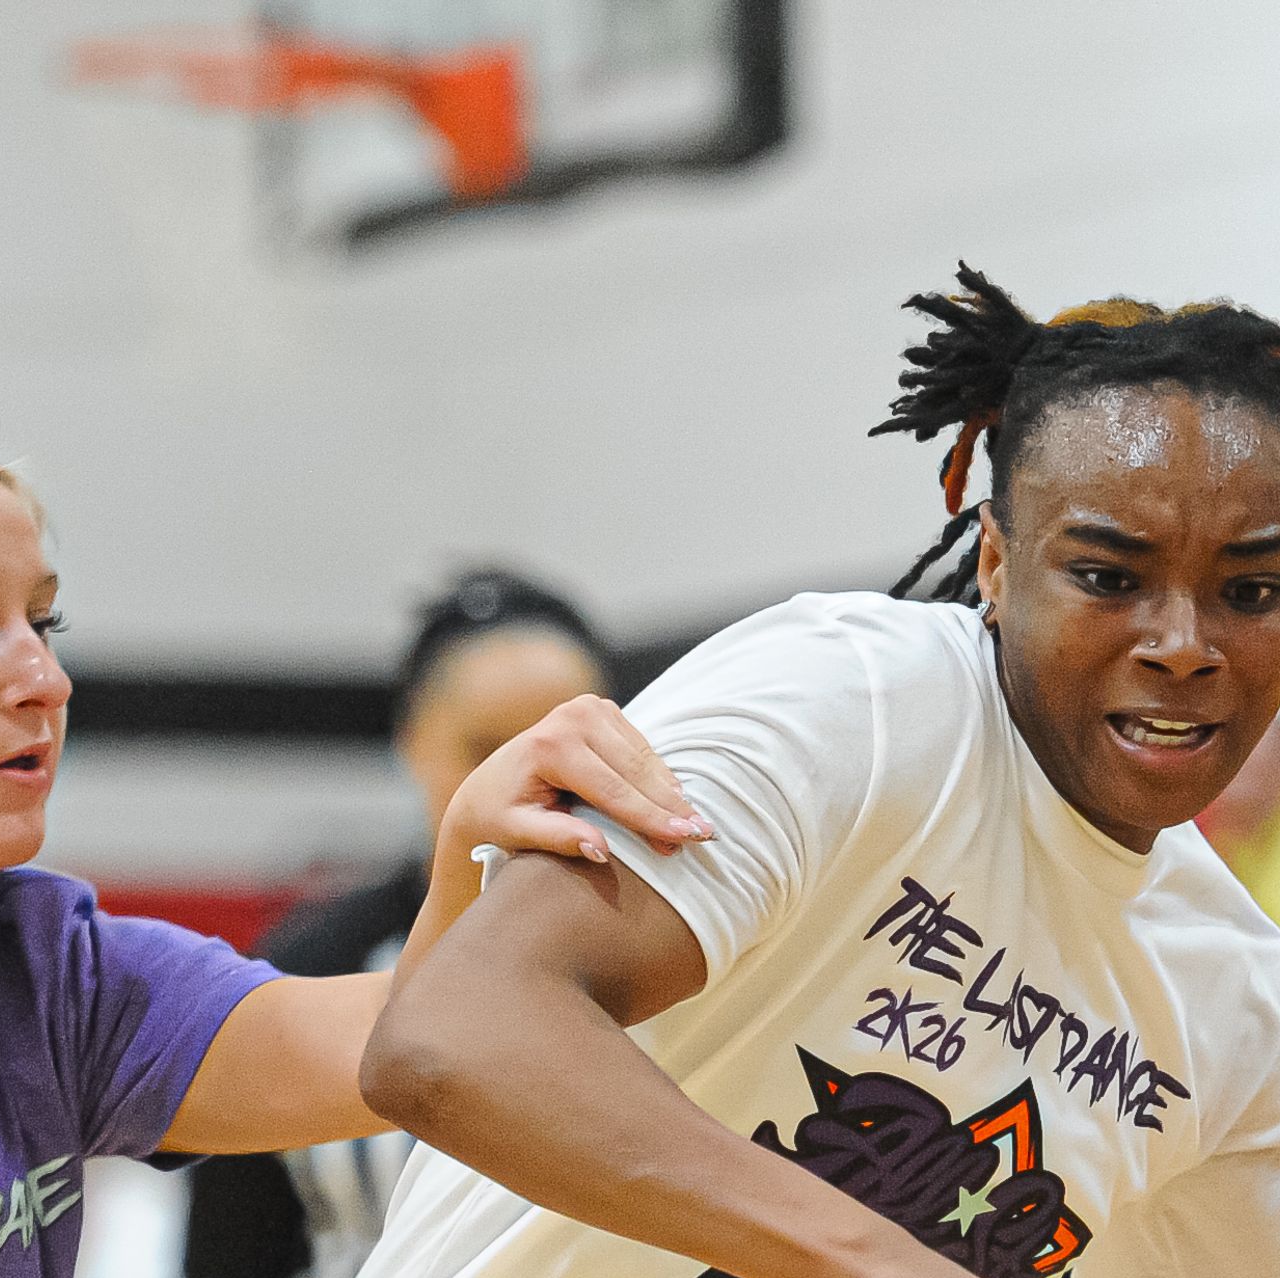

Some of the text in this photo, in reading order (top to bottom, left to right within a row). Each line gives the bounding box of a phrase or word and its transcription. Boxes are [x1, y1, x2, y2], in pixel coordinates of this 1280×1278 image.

[852, 985, 967, 1072] 2K26
[863, 876, 984, 986] THE
[1052, 1012, 1192, 1134] DANCE
